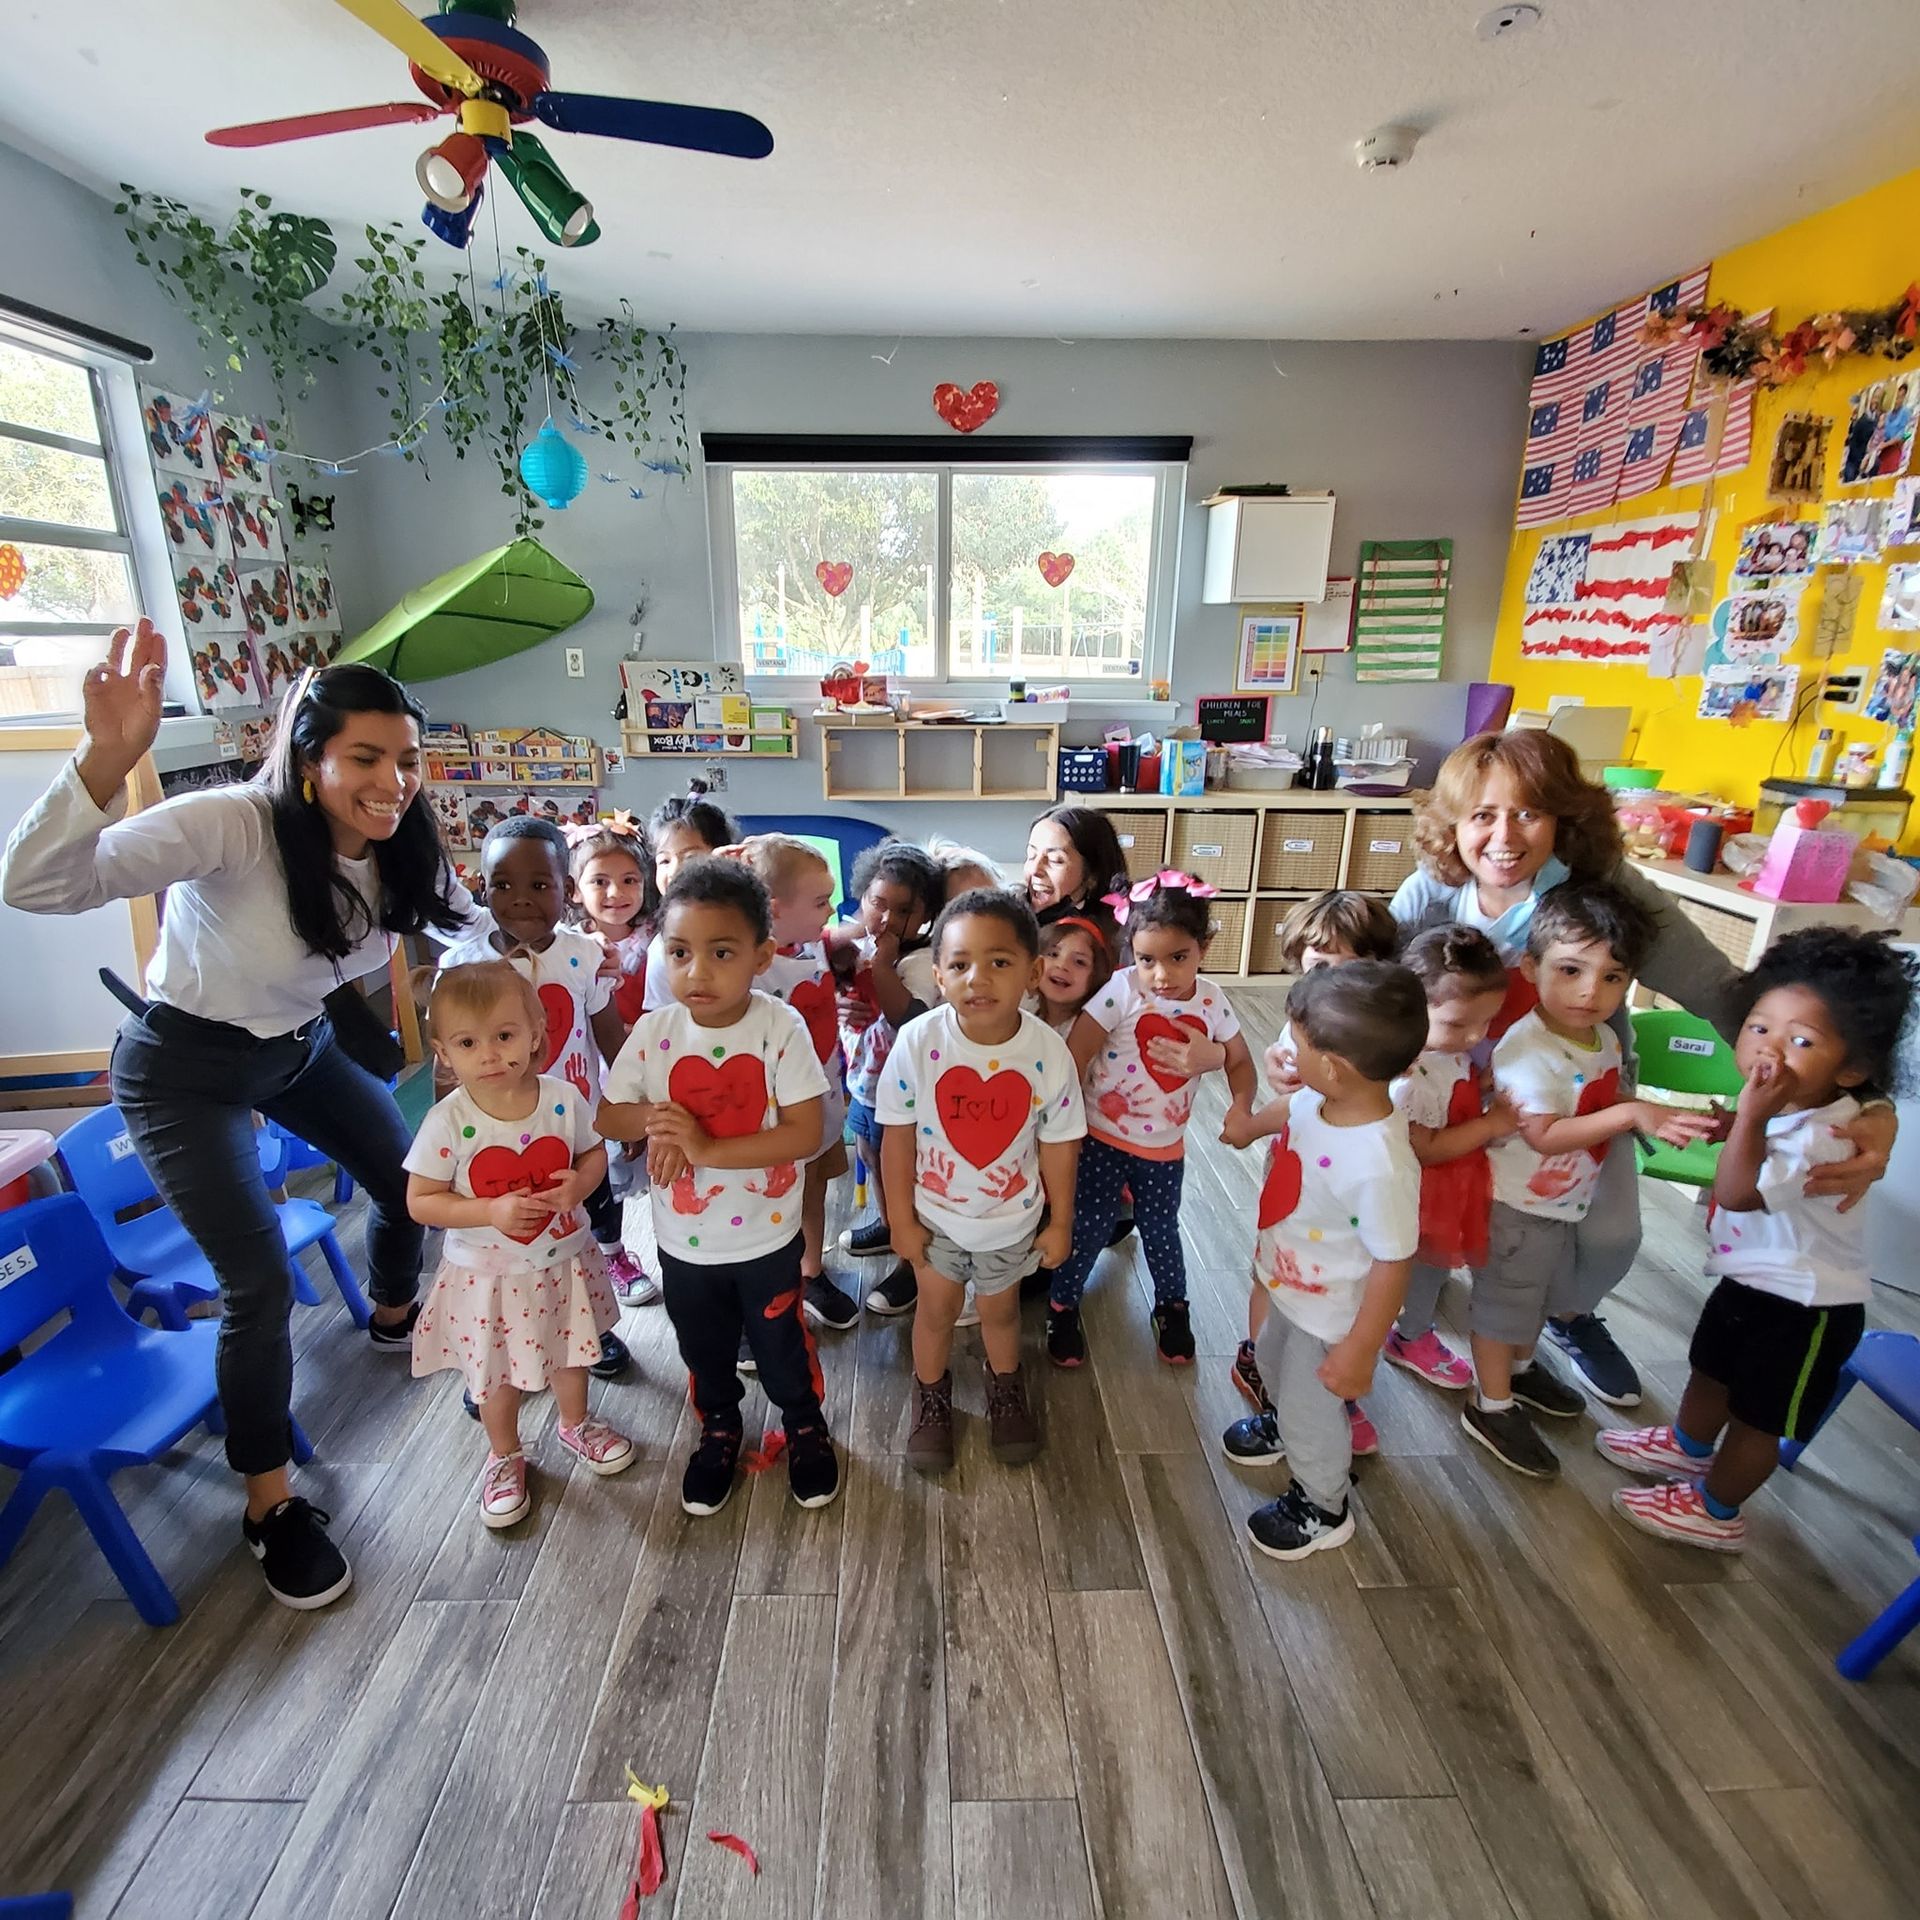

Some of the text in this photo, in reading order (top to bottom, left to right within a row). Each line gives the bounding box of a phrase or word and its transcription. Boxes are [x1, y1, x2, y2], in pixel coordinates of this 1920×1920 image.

[1200, 700, 1240, 709] CHILDREN
[654, 735, 674, 746] Box
[1673, 1039, 1706, 1052] Sarai
[949, 1095, 1009, 1121] I U
[16, 1255, 31, 1269] S.
